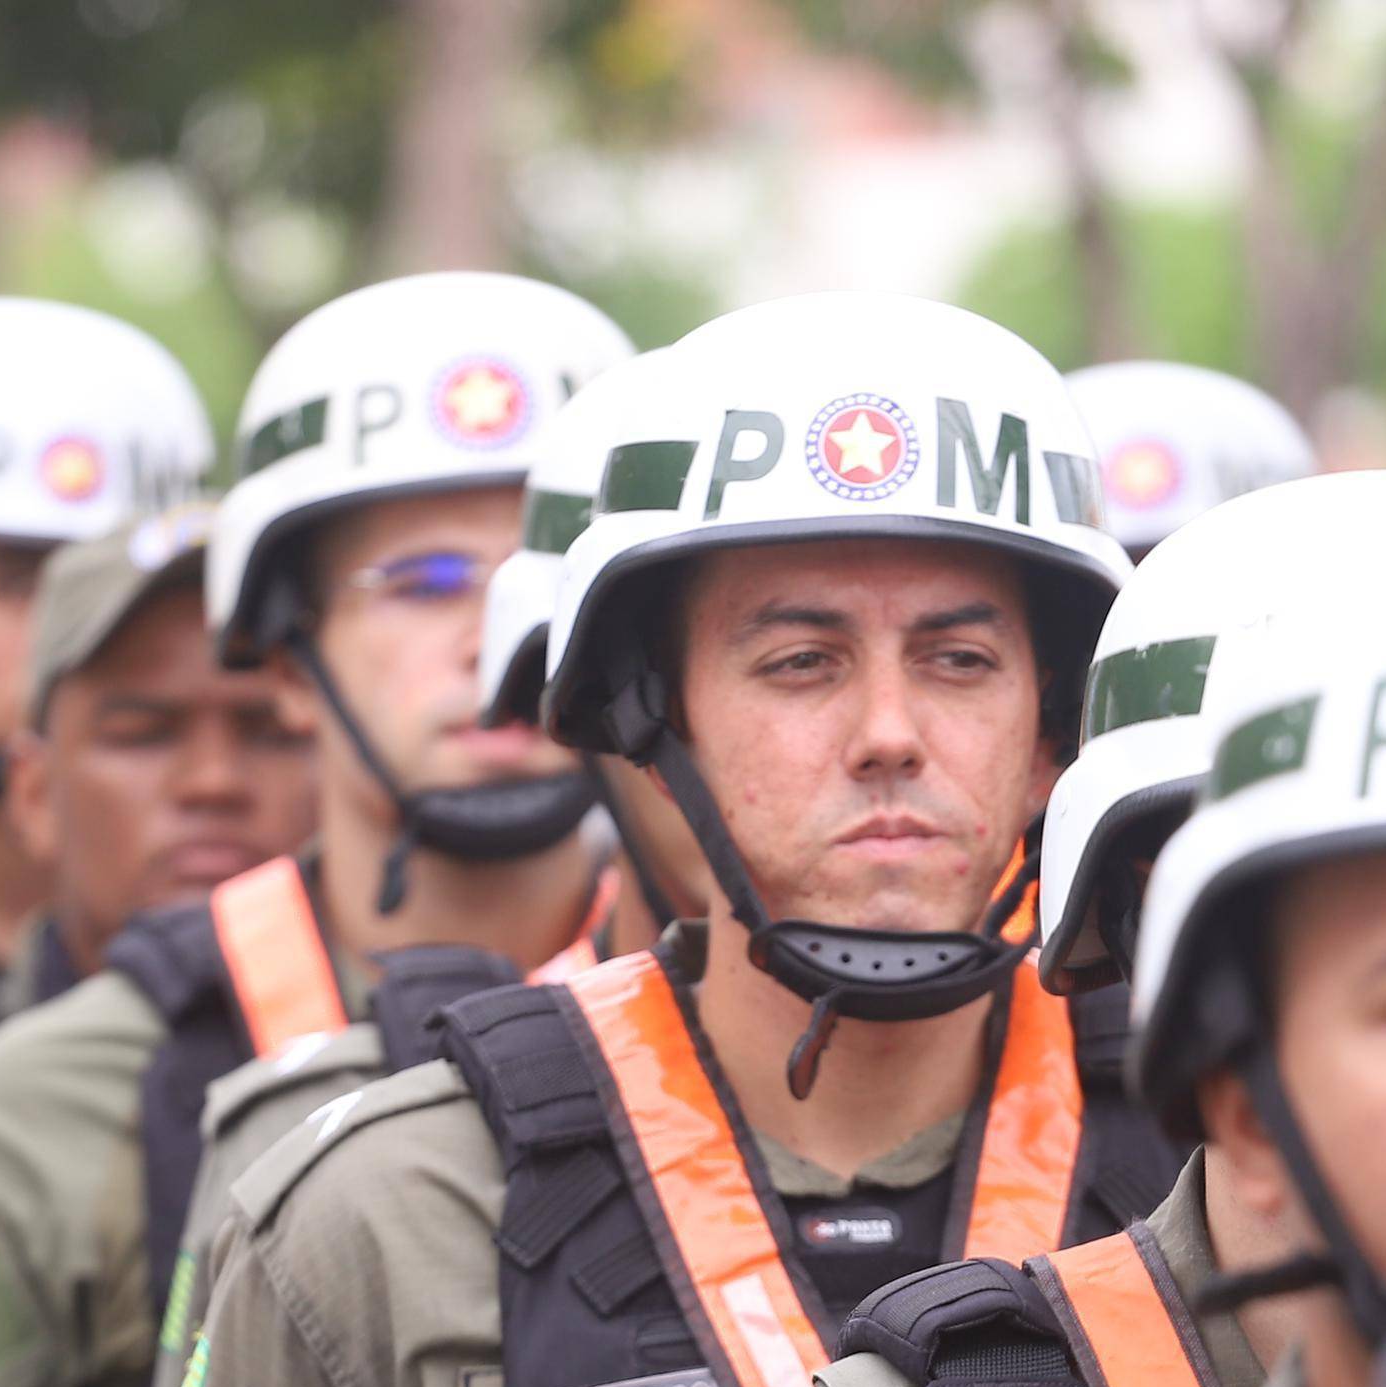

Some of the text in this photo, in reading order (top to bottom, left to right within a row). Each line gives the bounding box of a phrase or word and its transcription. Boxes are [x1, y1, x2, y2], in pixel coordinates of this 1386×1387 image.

[355, 382, 405, 467] P
[703, 397, 1031, 526] P M
